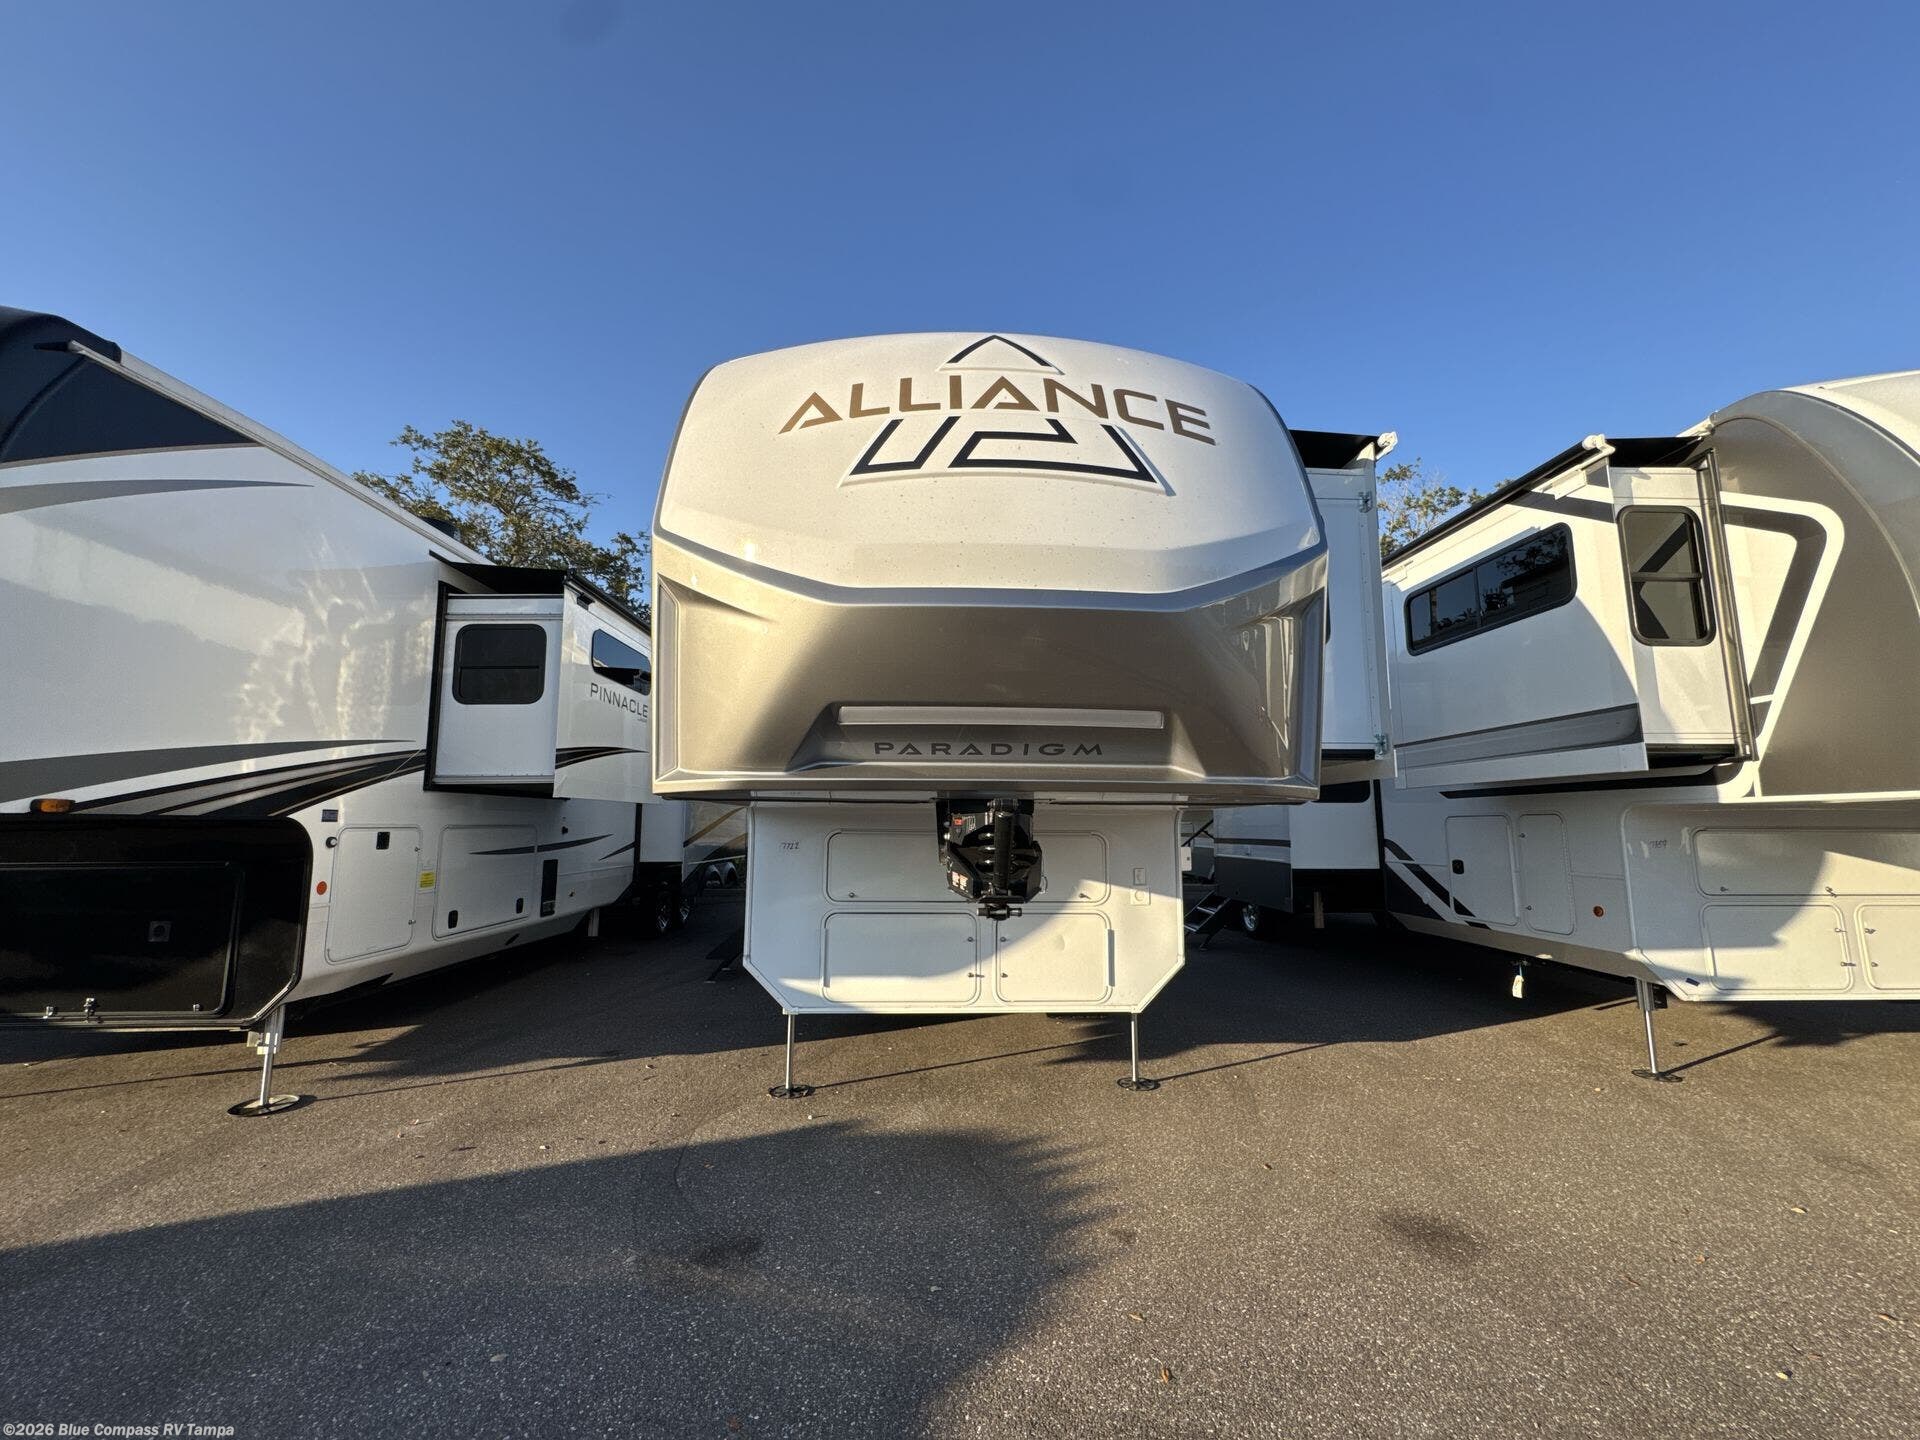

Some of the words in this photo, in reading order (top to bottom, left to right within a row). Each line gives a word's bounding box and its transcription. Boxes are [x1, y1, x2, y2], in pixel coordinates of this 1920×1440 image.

[778, 375, 1217, 446] ALLIANCE
[590, 682, 649, 718] PINNACLE
[873, 742, 1103, 756] PARADIGM
